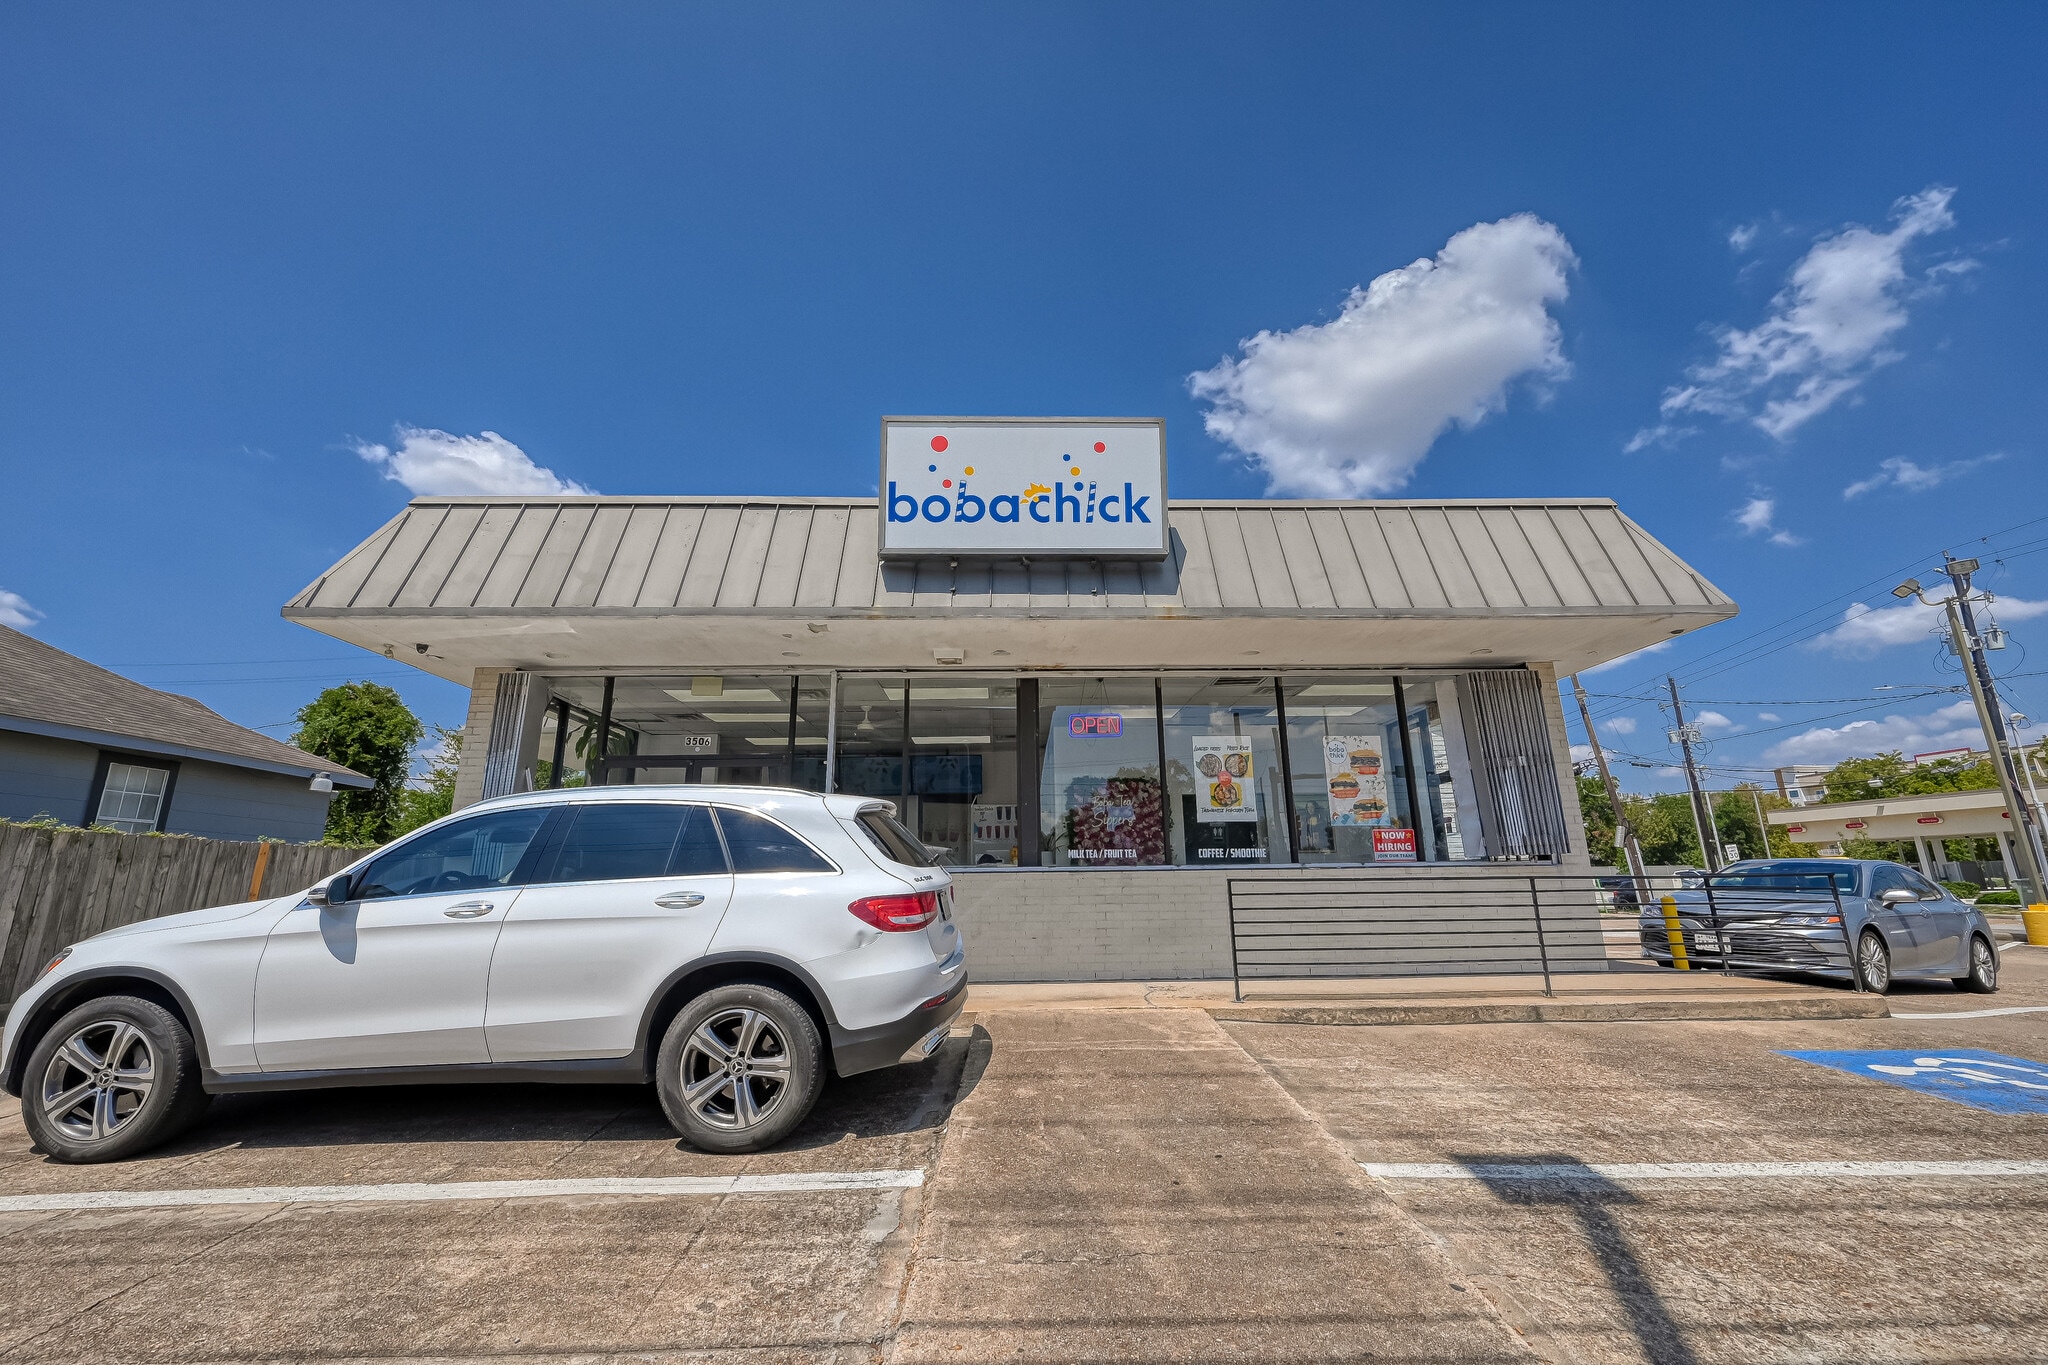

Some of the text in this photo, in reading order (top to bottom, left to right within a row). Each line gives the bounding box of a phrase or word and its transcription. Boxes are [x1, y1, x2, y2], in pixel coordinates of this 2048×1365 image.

[1071, 717, 1120, 734] OPEN
[685, 737, 711, 746] 3506
[1091, 795, 1134, 809] Boba Tea
[1381, 832, 1405, 840] NOW
[1378, 842, 1412, 851] HIRING
[1067, 849, 1085, 858] MILK
[1085, 849, 1098, 858] TEA
[1104, 848, 1123, 858] FRUIT
[1124, 848, 1137, 858] TEA
[1198, 848, 1224, 858] COFFEE
[1230, 848, 1267, 858] SMOOTHIE
